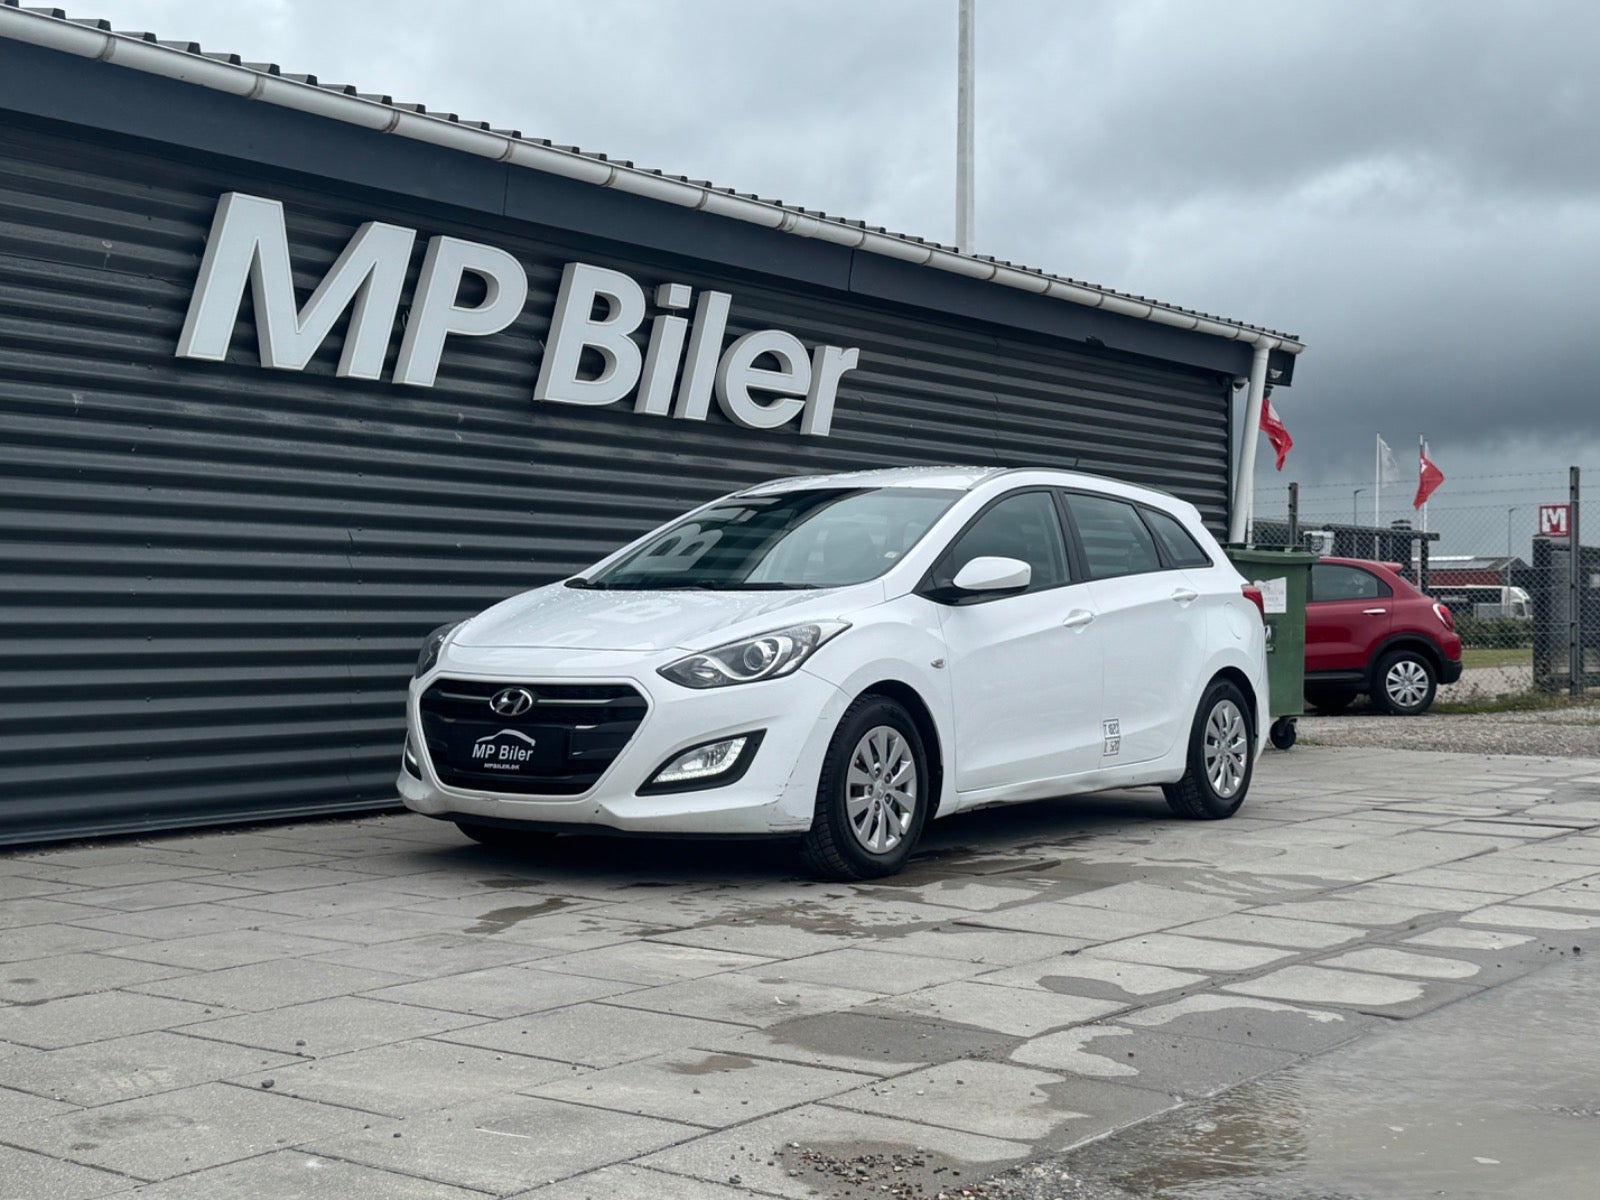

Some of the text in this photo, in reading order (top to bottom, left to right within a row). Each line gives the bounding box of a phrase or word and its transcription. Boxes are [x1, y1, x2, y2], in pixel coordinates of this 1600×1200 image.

[175, 191, 860, 437] MP Biler
[472, 744, 534, 761] MP Biler
